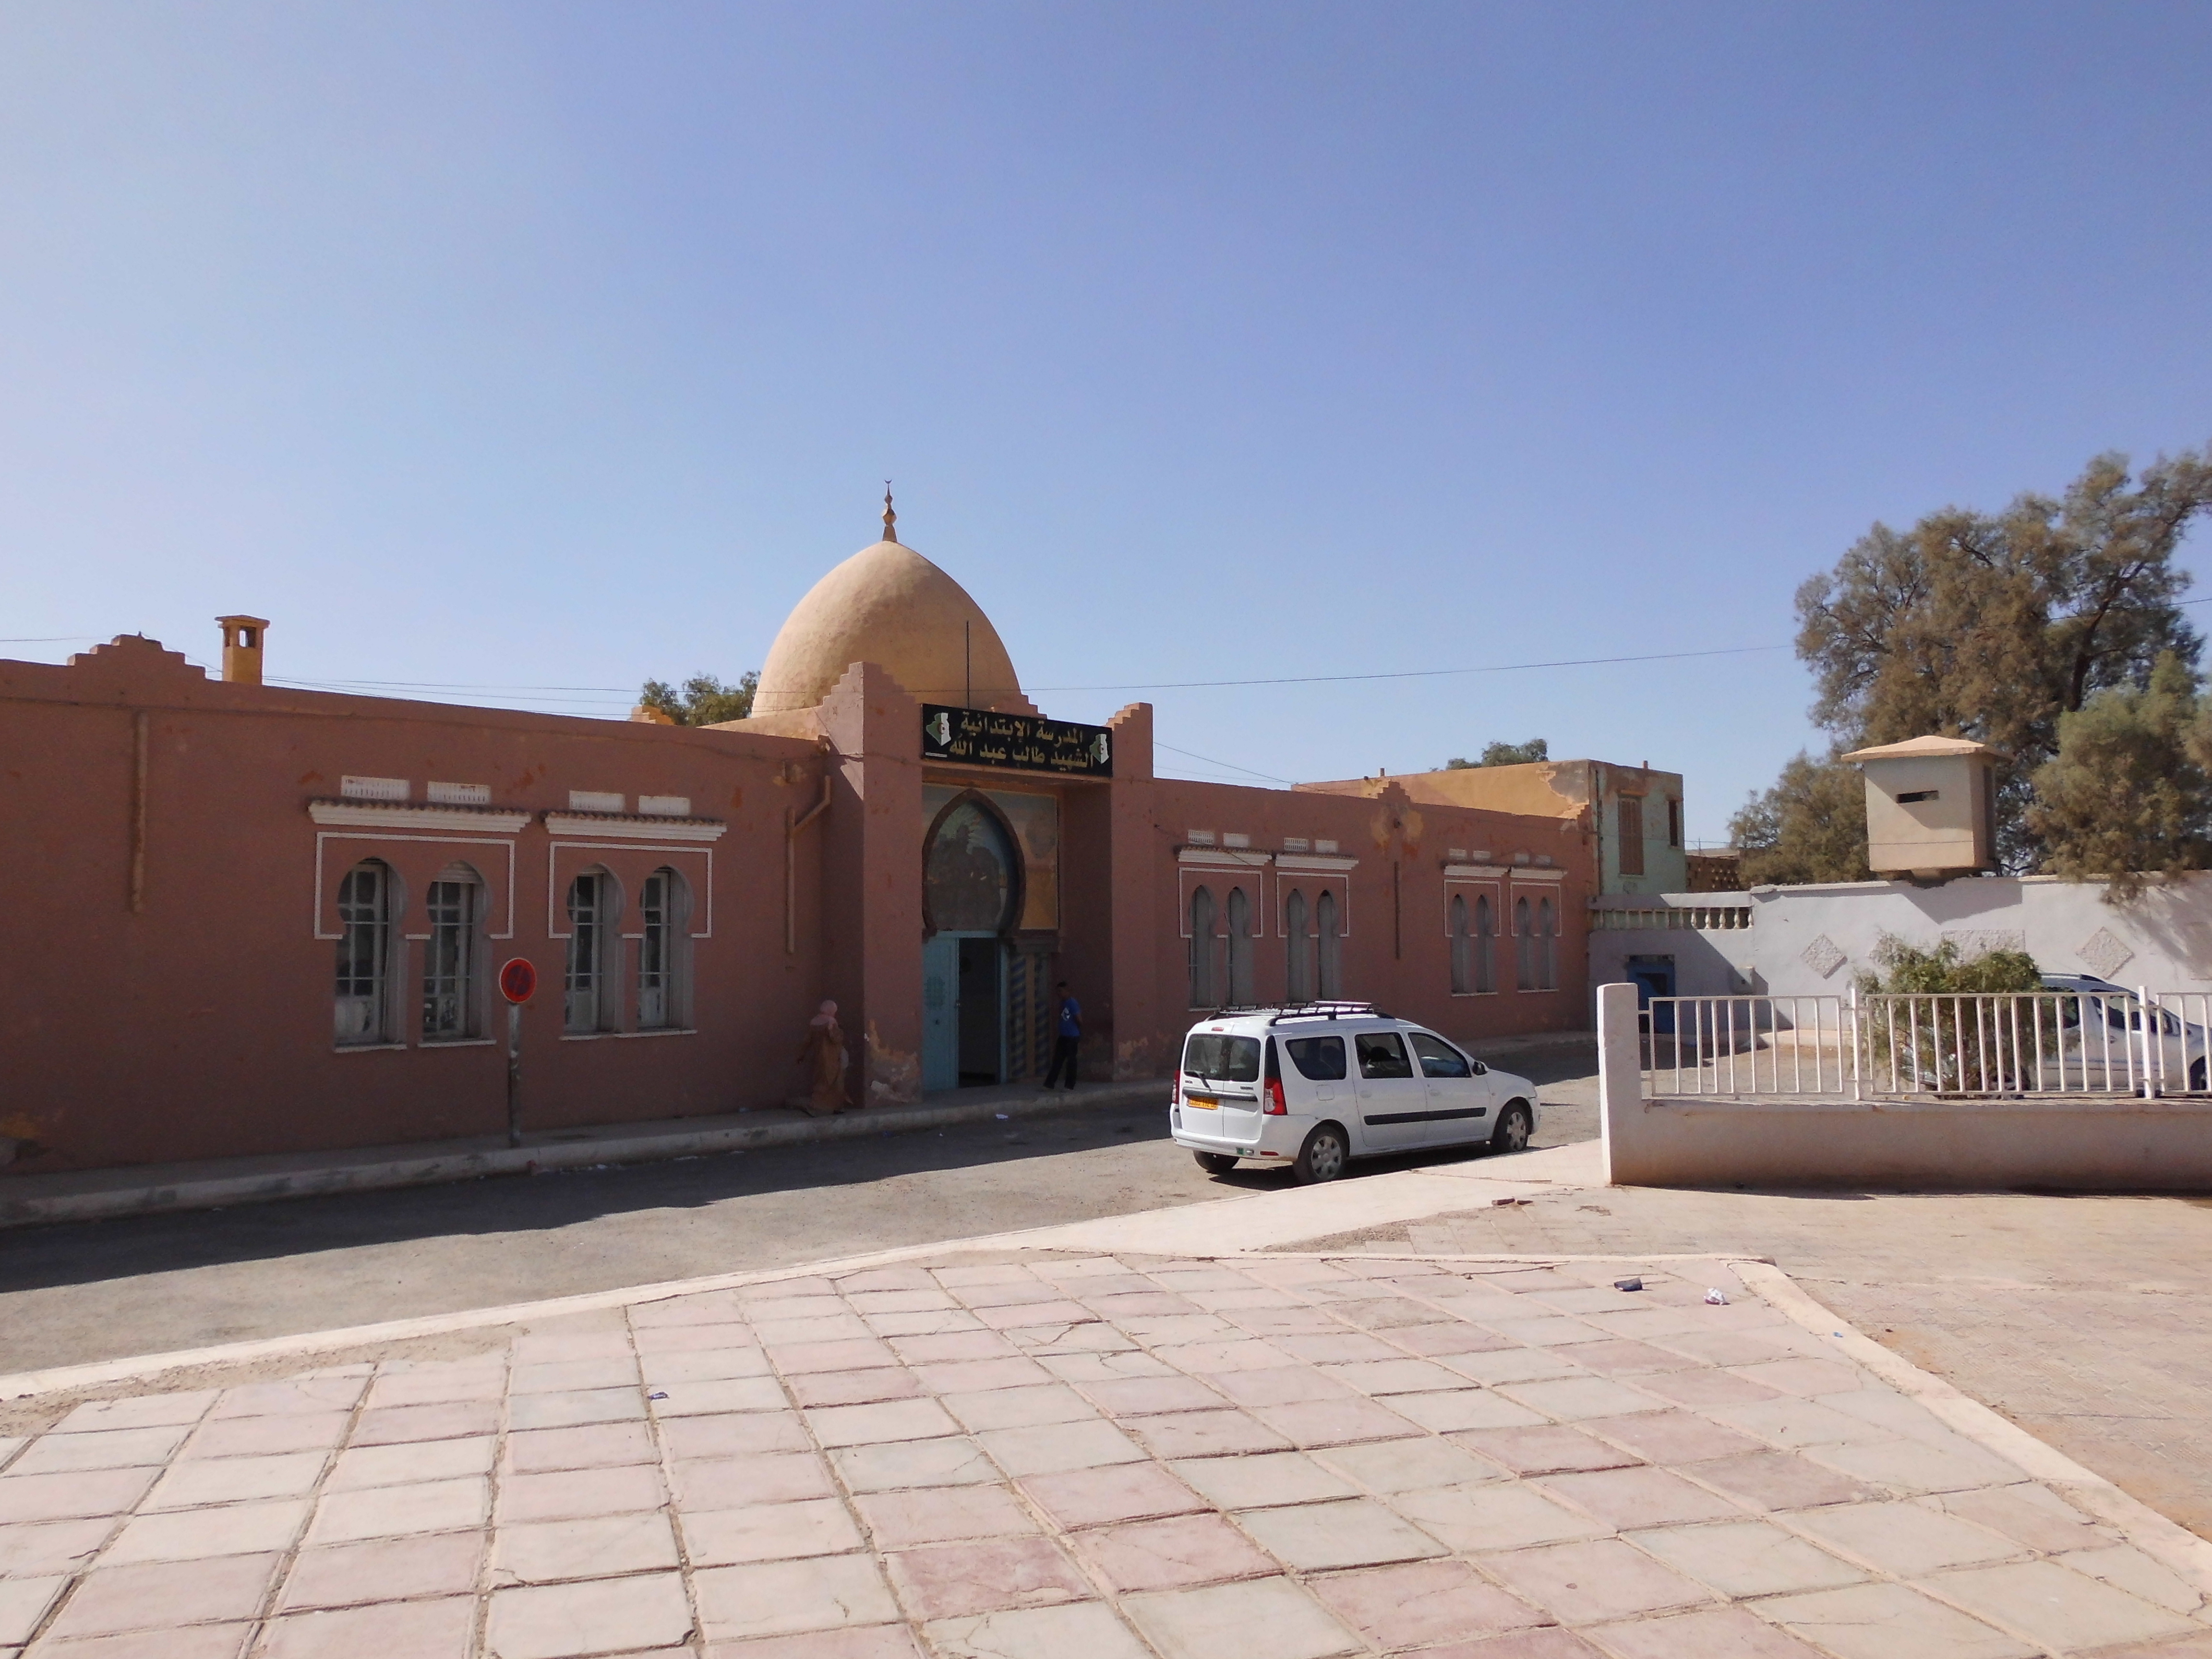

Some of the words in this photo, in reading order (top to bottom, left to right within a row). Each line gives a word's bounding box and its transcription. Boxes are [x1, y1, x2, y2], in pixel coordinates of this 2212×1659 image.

[950, 733, 973, 756] الله
[1036, 721, 1082, 747] المدرسة
[980, 744, 1007, 764] عبد
[1012, 745, 1045, 767] طالب
[1051, 748, 1093, 771] الشهيد
